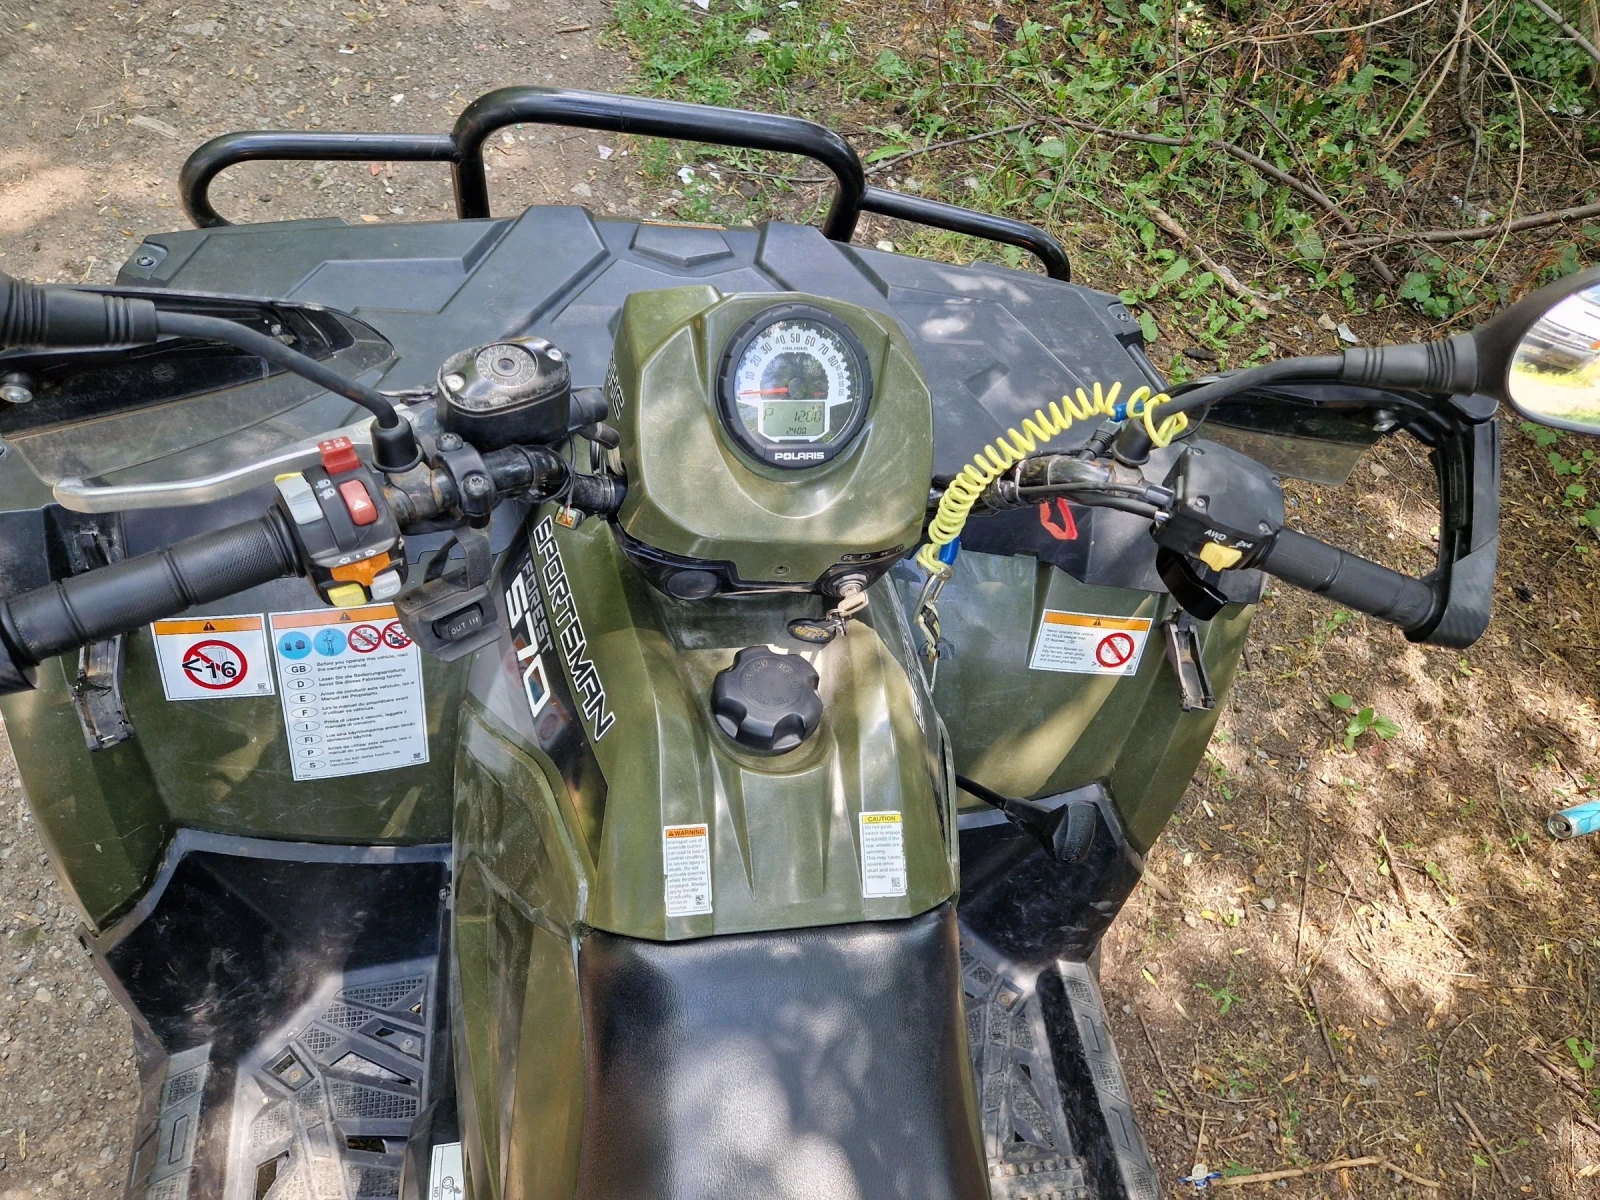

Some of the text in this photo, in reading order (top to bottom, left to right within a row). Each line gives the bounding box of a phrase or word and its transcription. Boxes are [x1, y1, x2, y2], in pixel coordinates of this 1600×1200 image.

[776, 334, 786, 346] 40
[790, 333, 800, 343] 50
[804, 336, 816, 346] 60
[760, 343, 772, 355] 30
[818, 343, 829, 355] 70
[750, 355, 762, 367] 20
[828, 355, 838, 367] 80
[745, 372, 755, 380] 10
[794, 411, 822, 422] 1200
[774, 452, 824, 460] POLARIS
[1204, 529, 1227, 540] AWD
[522, 559, 552, 654] FOREST
[450, 616, 480, 635] OUT IN
[533, 514, 616, 743] SPORTSMAN
[506, 572, 550, 718] 570
[291, 665, 306, 673] GB
[434, 1187, 439, 1197] ON
